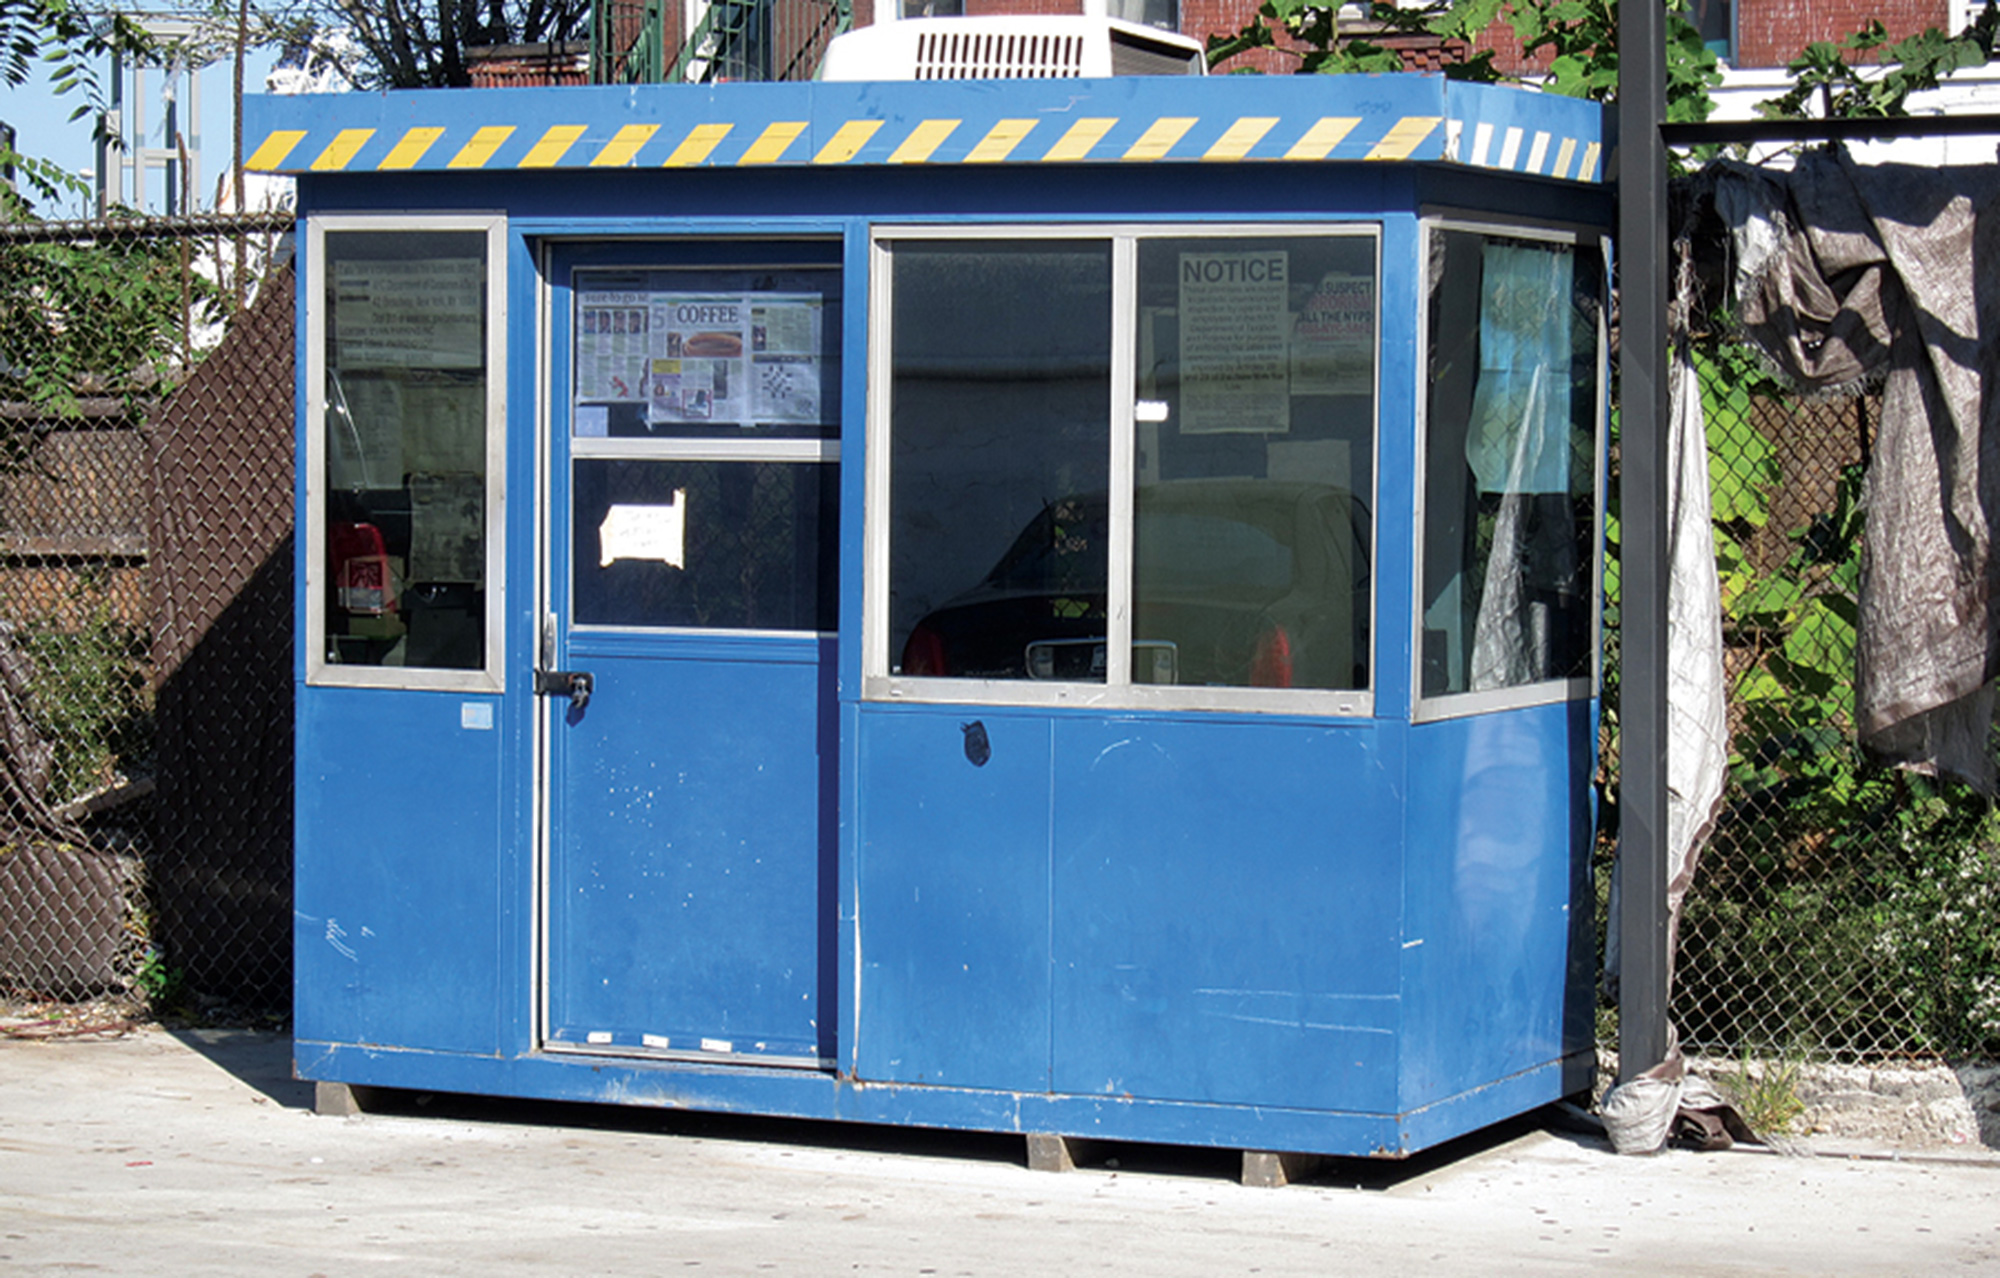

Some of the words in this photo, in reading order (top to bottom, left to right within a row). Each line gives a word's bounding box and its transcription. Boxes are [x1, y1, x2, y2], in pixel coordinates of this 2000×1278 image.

[1183, 258, 1284, 283] NOTICE
[1326, 281, 1371, 294] SUSPECT
[677, 304, 739, 324] COFFEE
[1296, 311, 1318, 323] ALL
[1321, 311, 1341, 322] THE
